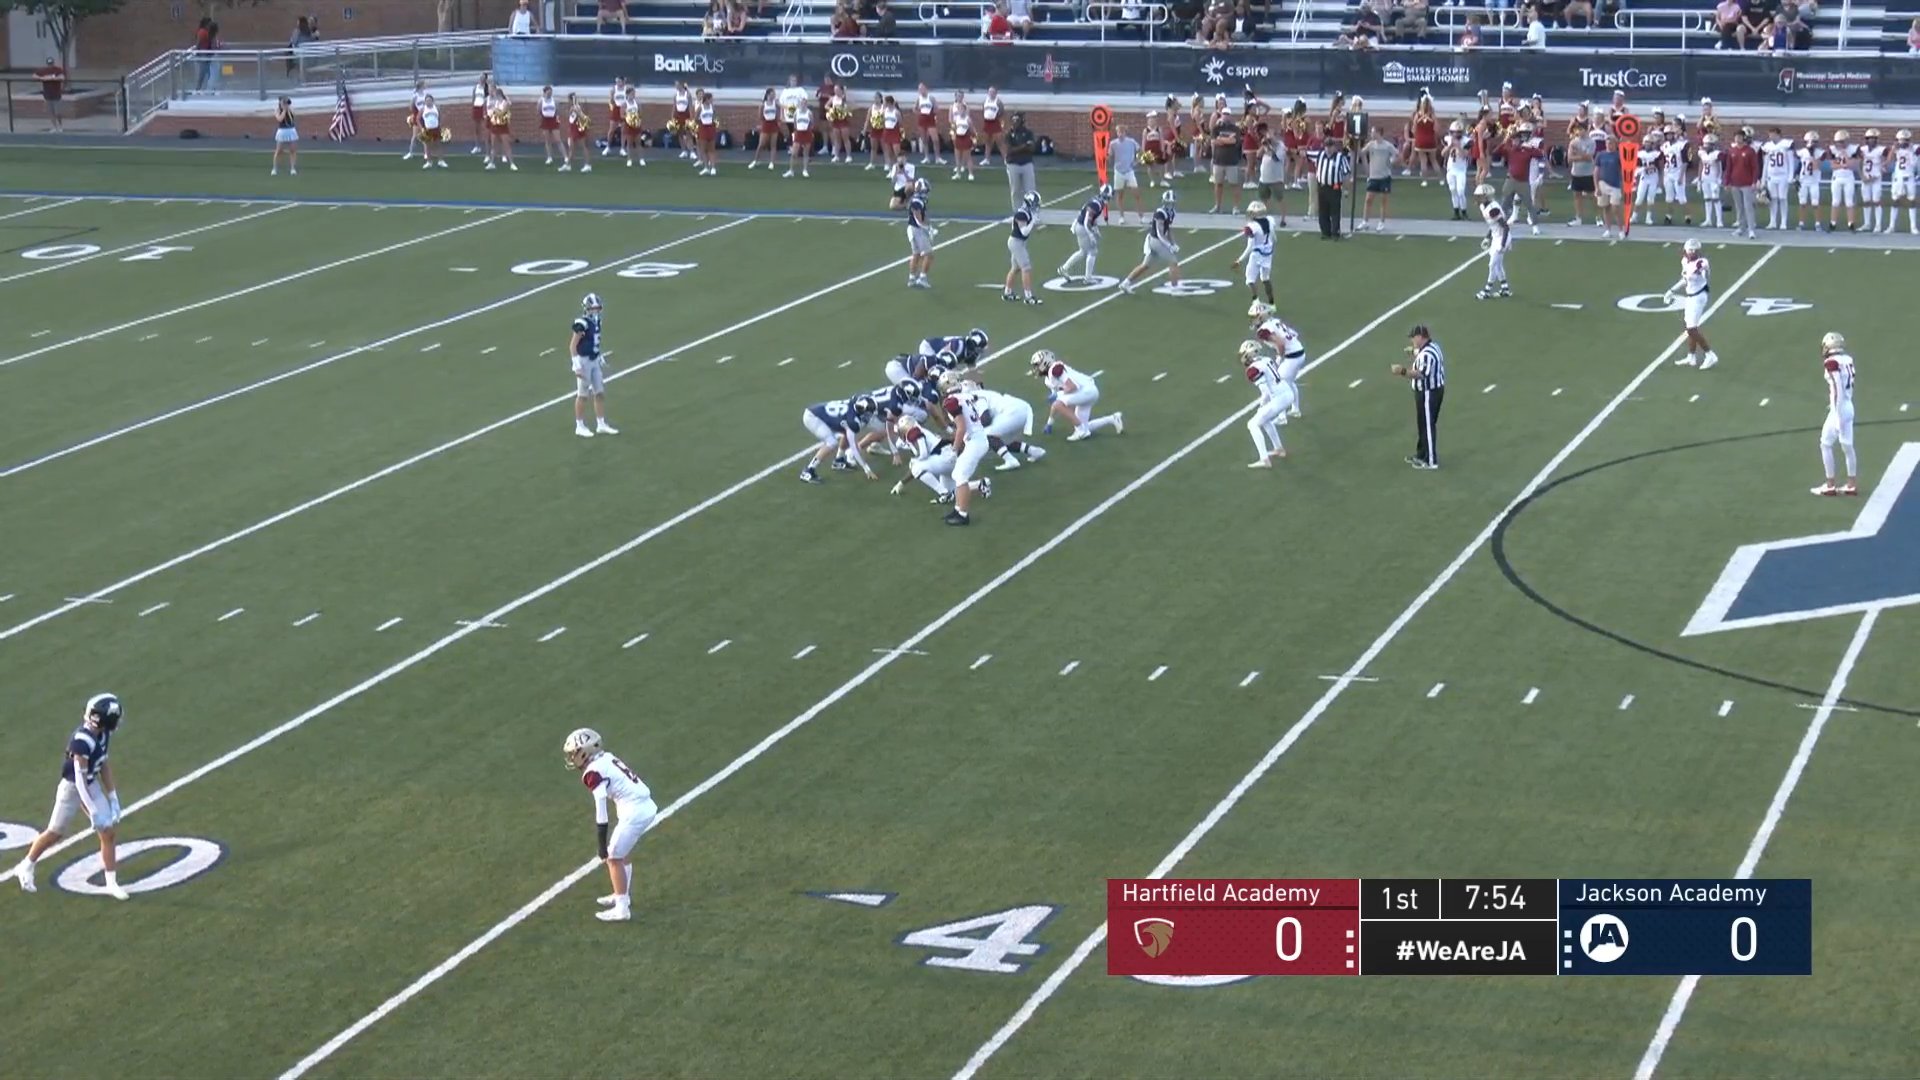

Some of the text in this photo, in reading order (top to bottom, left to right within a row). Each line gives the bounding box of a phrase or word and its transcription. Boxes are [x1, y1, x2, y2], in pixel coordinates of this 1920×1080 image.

[655, 54, 725, 73] BankPlus
[862, 55, 902, 64] CAPITAL
[1406, 66, 1470, 74] MISSISSIPPI
[1579, 67, 1667, 87] TrustCare
[1406, 74, 1470, 83] SMART HOMES
[1352, 114, 1361, 135] 1
[1769, 151, 1784, 167] 50
